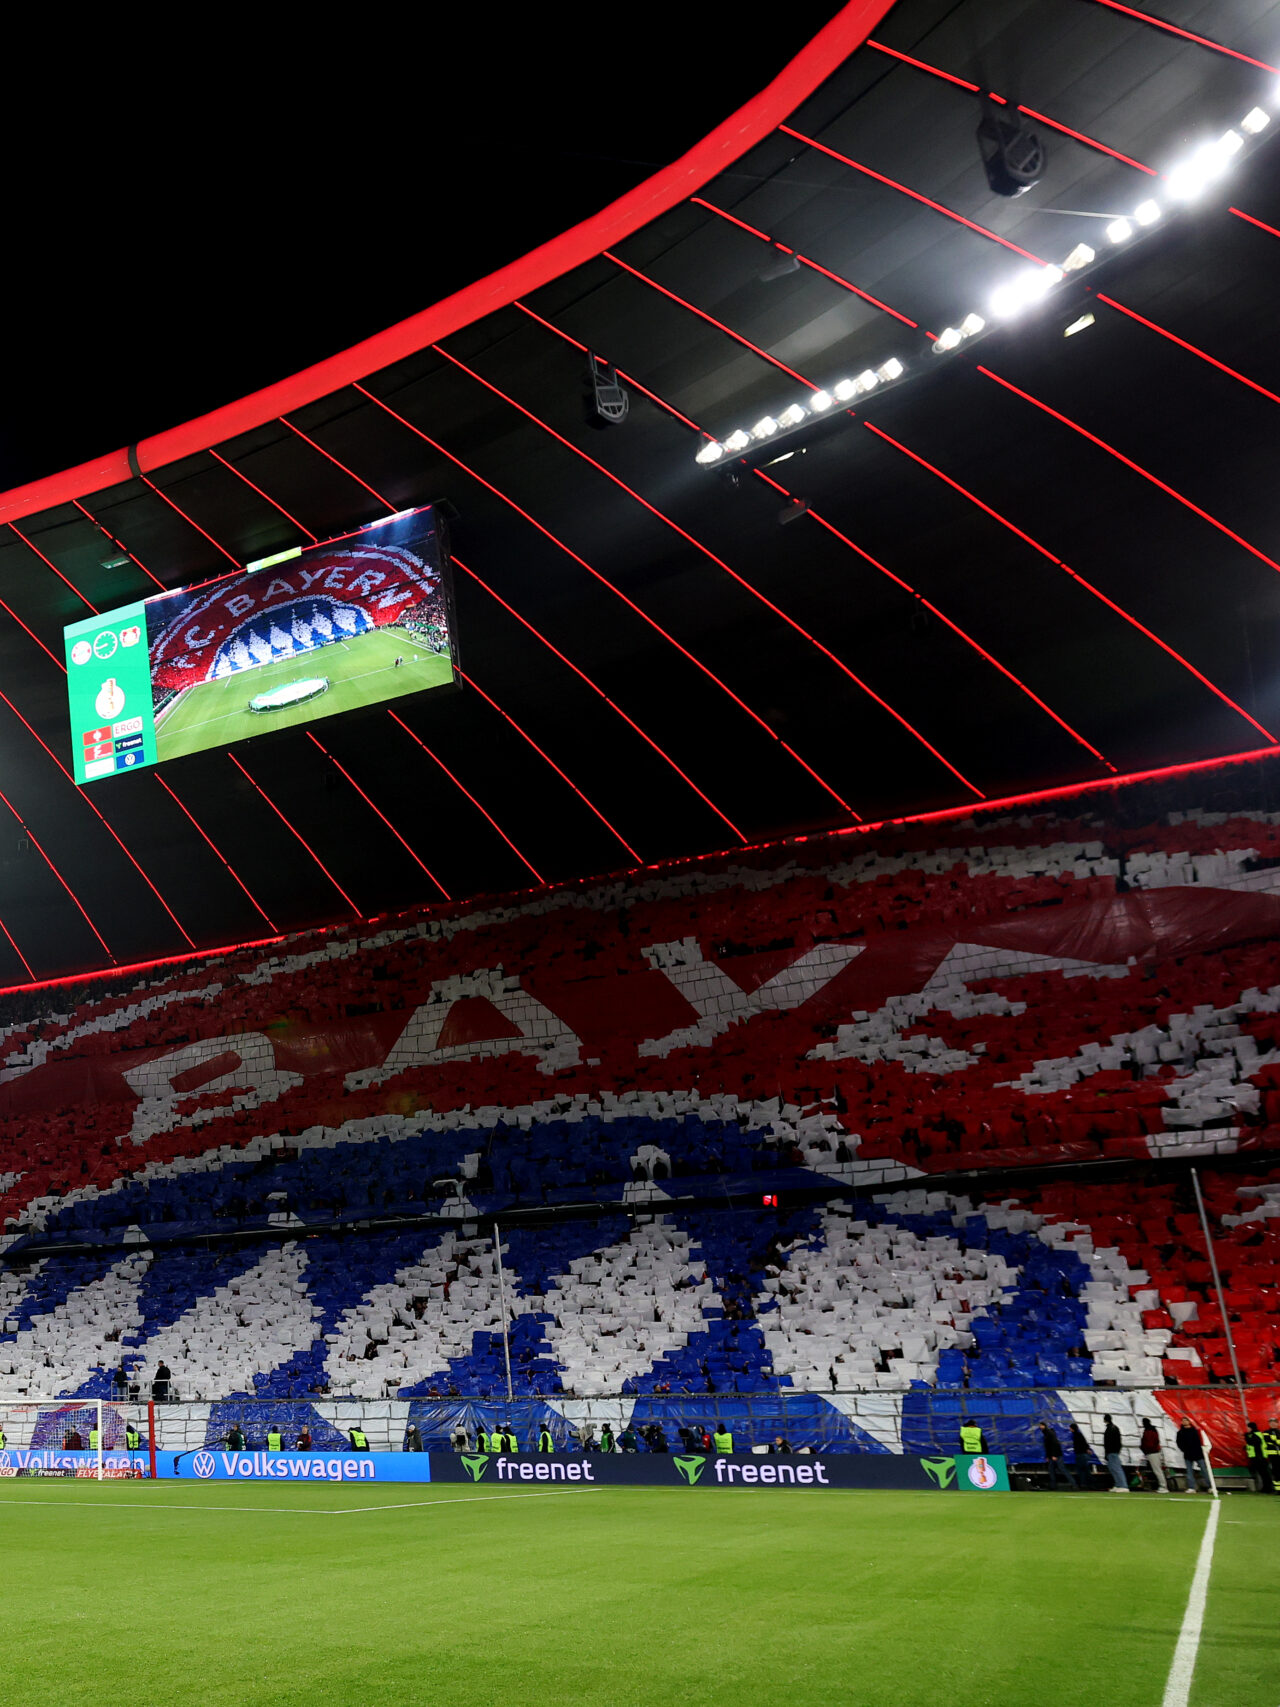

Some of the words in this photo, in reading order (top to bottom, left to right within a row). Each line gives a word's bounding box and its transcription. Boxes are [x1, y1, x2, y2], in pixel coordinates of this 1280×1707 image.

[114, 720, 141, 735] ERGO
[38, 1468, 65, 1478] freenet
[221, 1452, 376, 1482] Volkswagen
[496, 1457, 595, 1481] freenet
[714, 1457, 830, 1486] freenet
